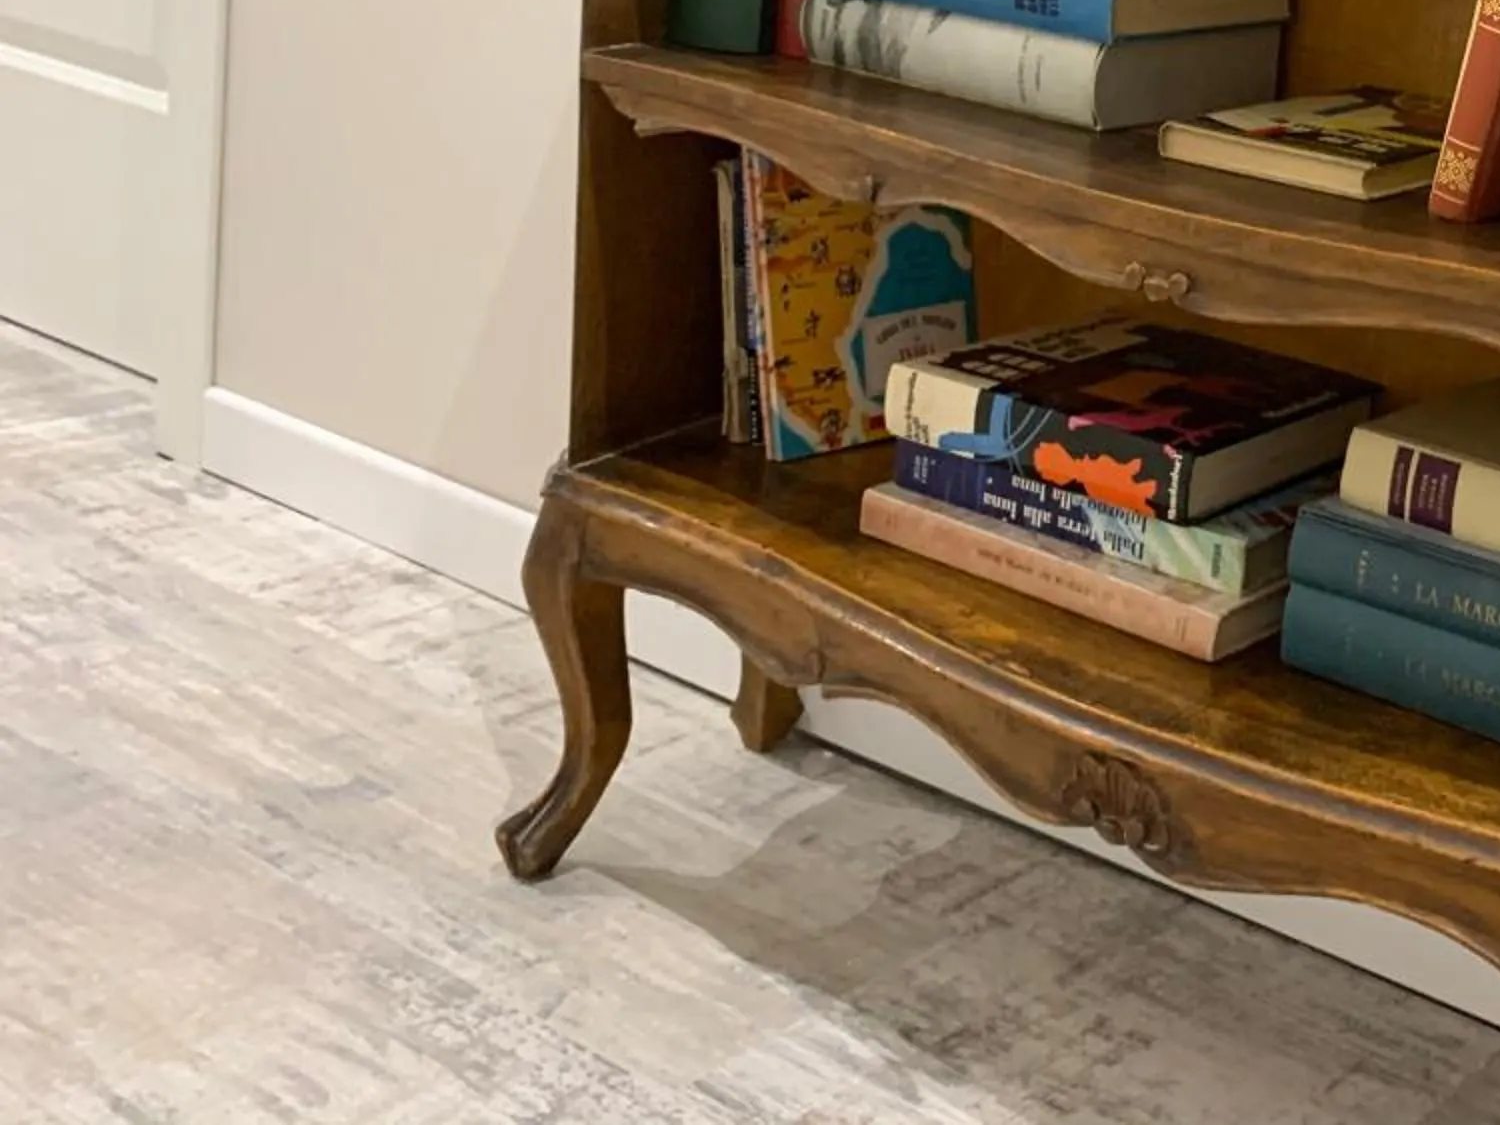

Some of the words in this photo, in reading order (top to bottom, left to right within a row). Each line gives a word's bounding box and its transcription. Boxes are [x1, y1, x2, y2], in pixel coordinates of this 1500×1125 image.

[982, 491, 1017, 520] luna
[1022, 505, 1053, 528] alla
[1057, 517, 1099, 541] terra
[1103, 530, 1145, 560] Dalla
[1415, 582, 1439, 610] LA
